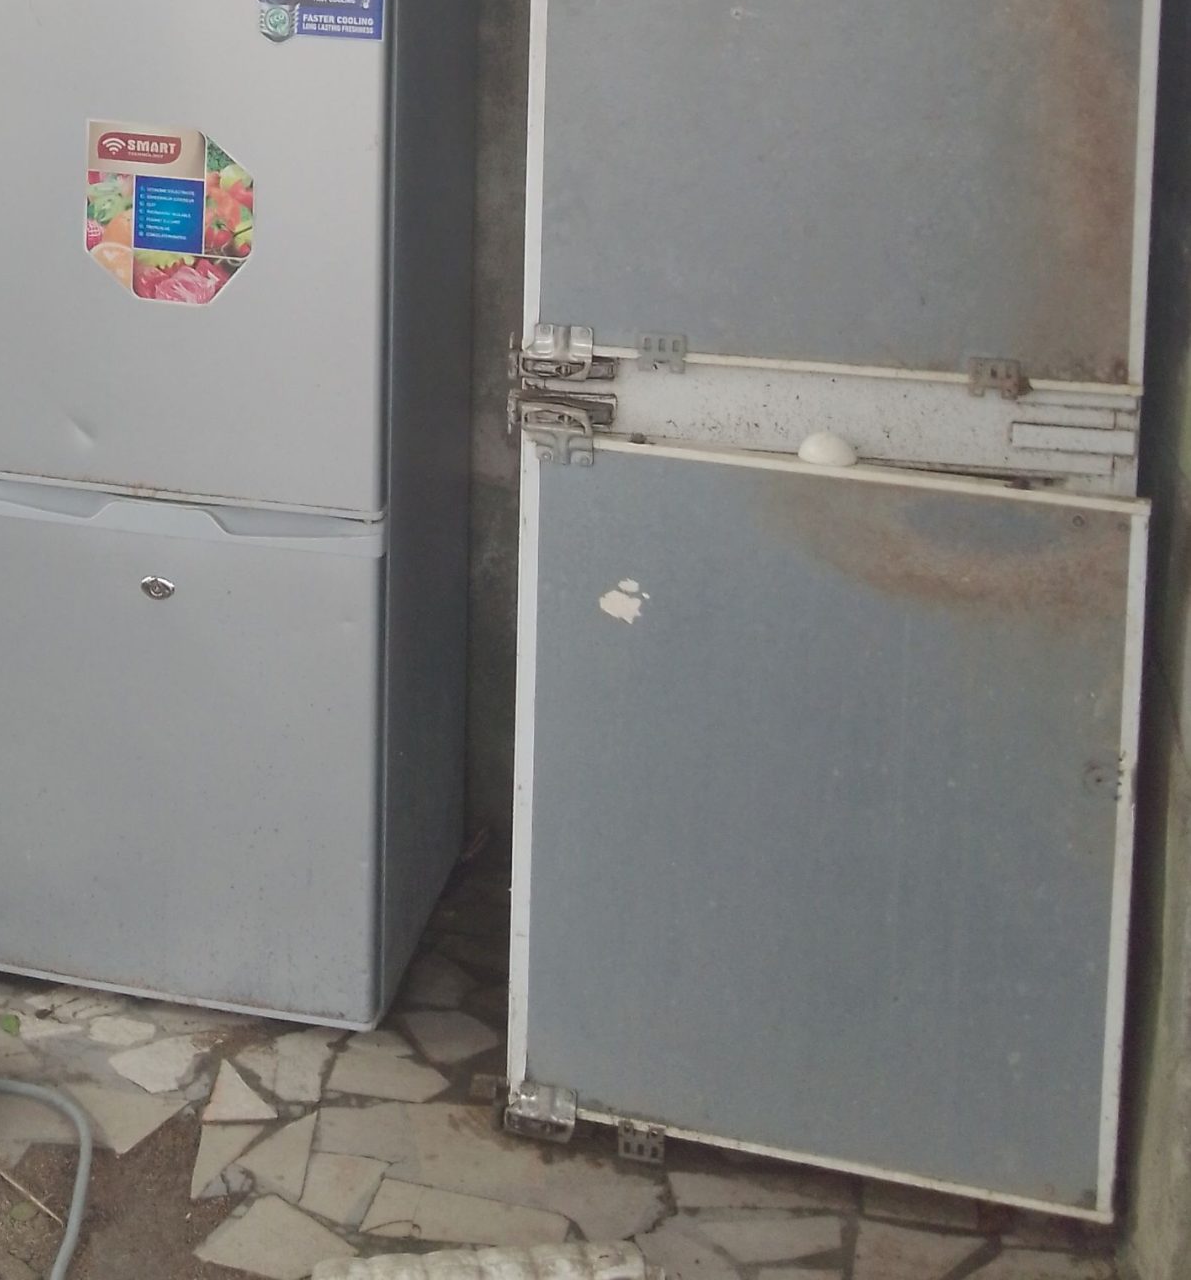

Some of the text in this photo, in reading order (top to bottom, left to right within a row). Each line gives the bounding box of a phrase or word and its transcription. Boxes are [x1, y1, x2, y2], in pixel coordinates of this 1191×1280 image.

[302, 14, 374, 26] FASTER COOLING
[127, 139, 176, 155] SMART
